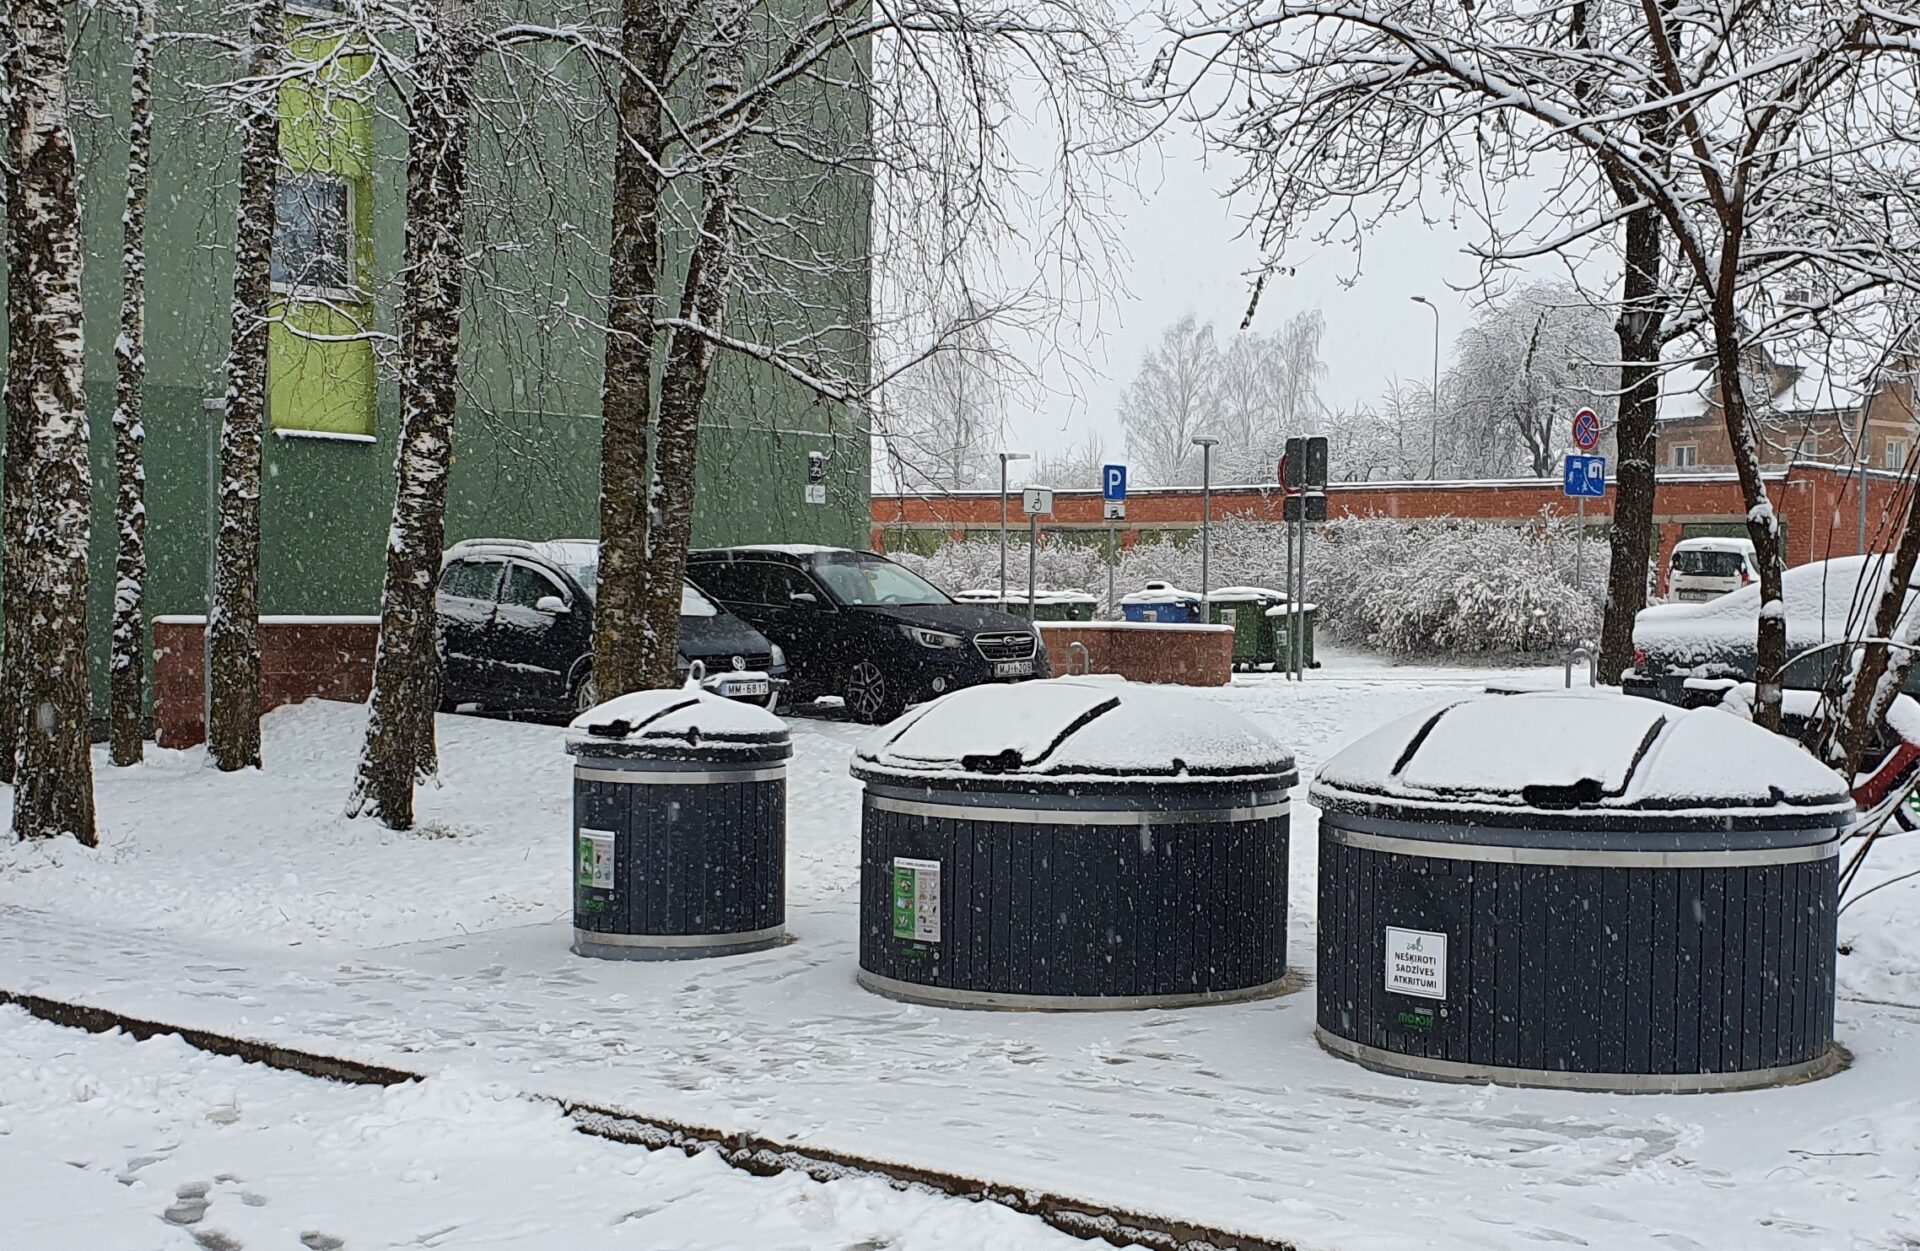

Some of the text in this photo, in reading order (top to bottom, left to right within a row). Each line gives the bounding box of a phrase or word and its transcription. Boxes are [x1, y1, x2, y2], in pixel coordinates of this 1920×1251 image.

[1108, 469, 1122, 496] P
[728, 683, 767, 695] MM-6812
[1394, 951, 1437, 965] NEŠĶIROTI
[1395, 963, 1435, 977] SADZĪVES
[1393, 974, 1437, 989] ATKRITUMI
